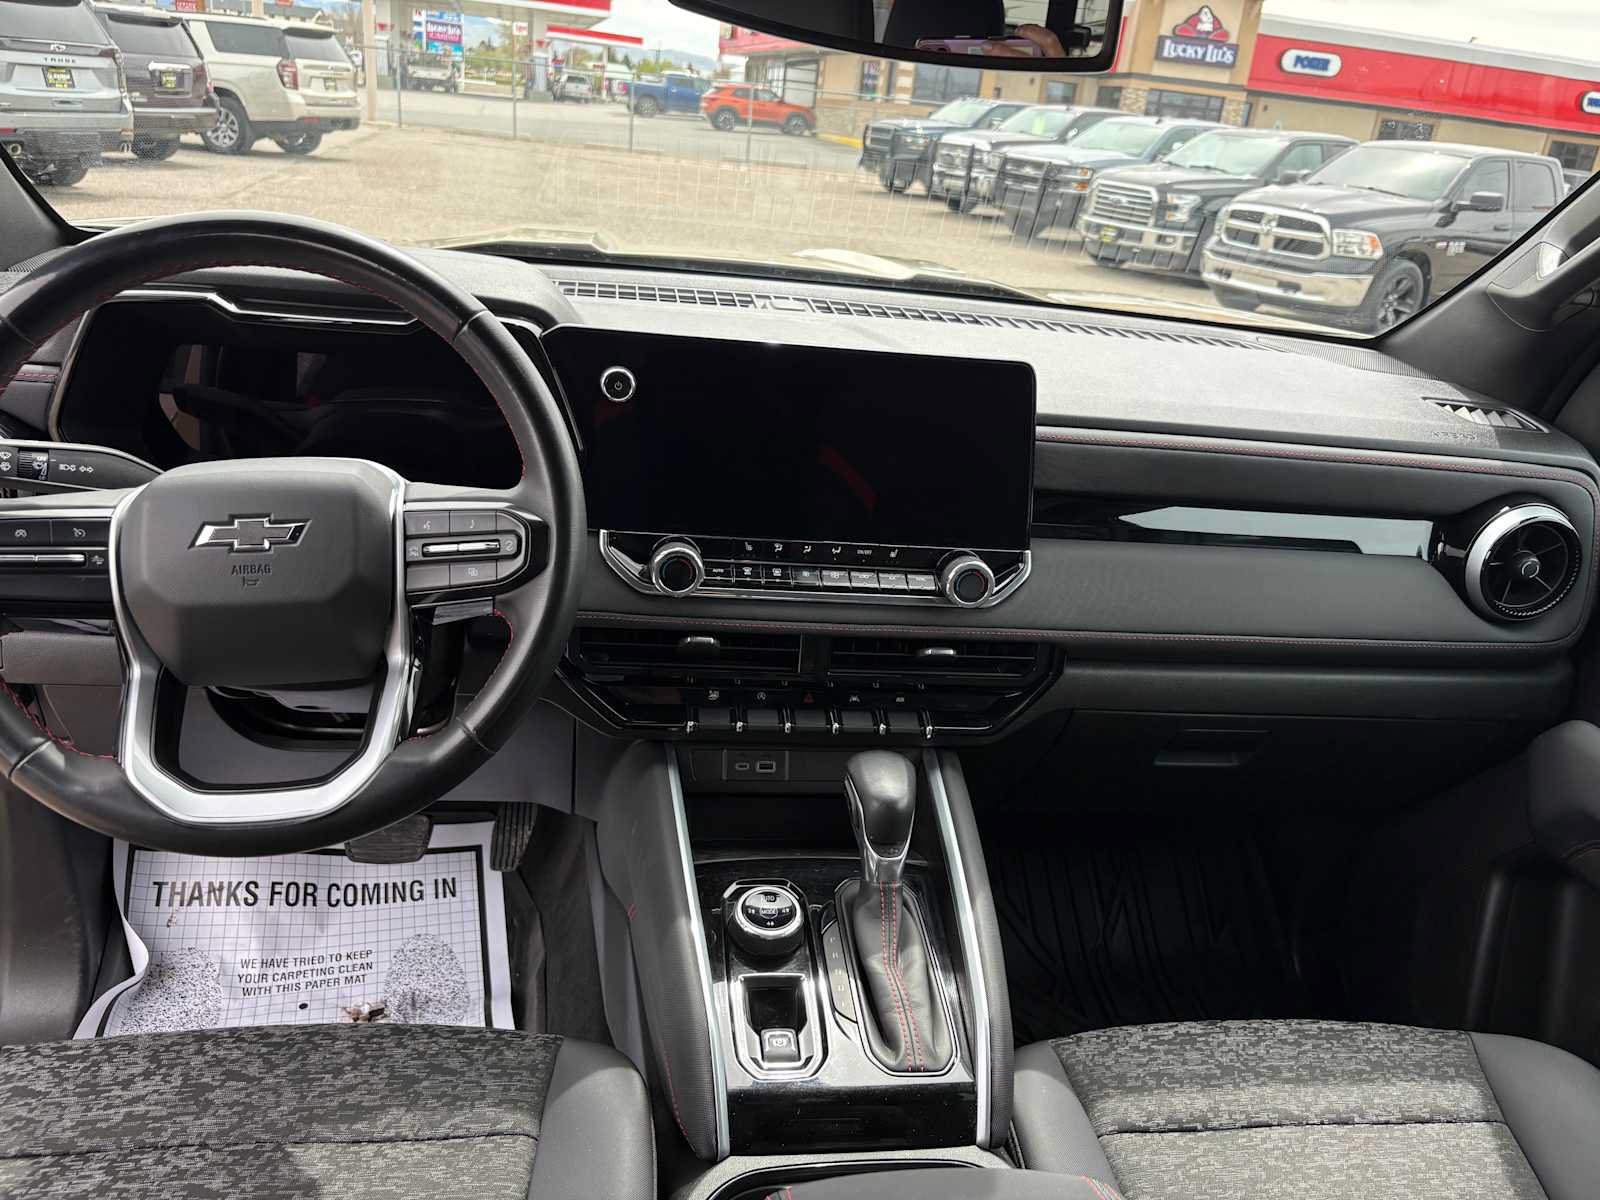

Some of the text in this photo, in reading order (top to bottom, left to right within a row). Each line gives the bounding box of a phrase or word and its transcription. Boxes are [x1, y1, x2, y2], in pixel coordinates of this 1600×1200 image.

[1163, 40, 1235, 64] LUCKY LU'S
[231, 564, 272, 576] AIRBAG
[152, 877, 458, 908] THANKS FOR COMING IN
[240, 949, 373, 969] WE HAVE TRIED TO KEEP
[237, 961, 374, 984] YOUR CARPETING CLEAN
[242, 974, 368, 997] WITH THIS PAPER MAT
